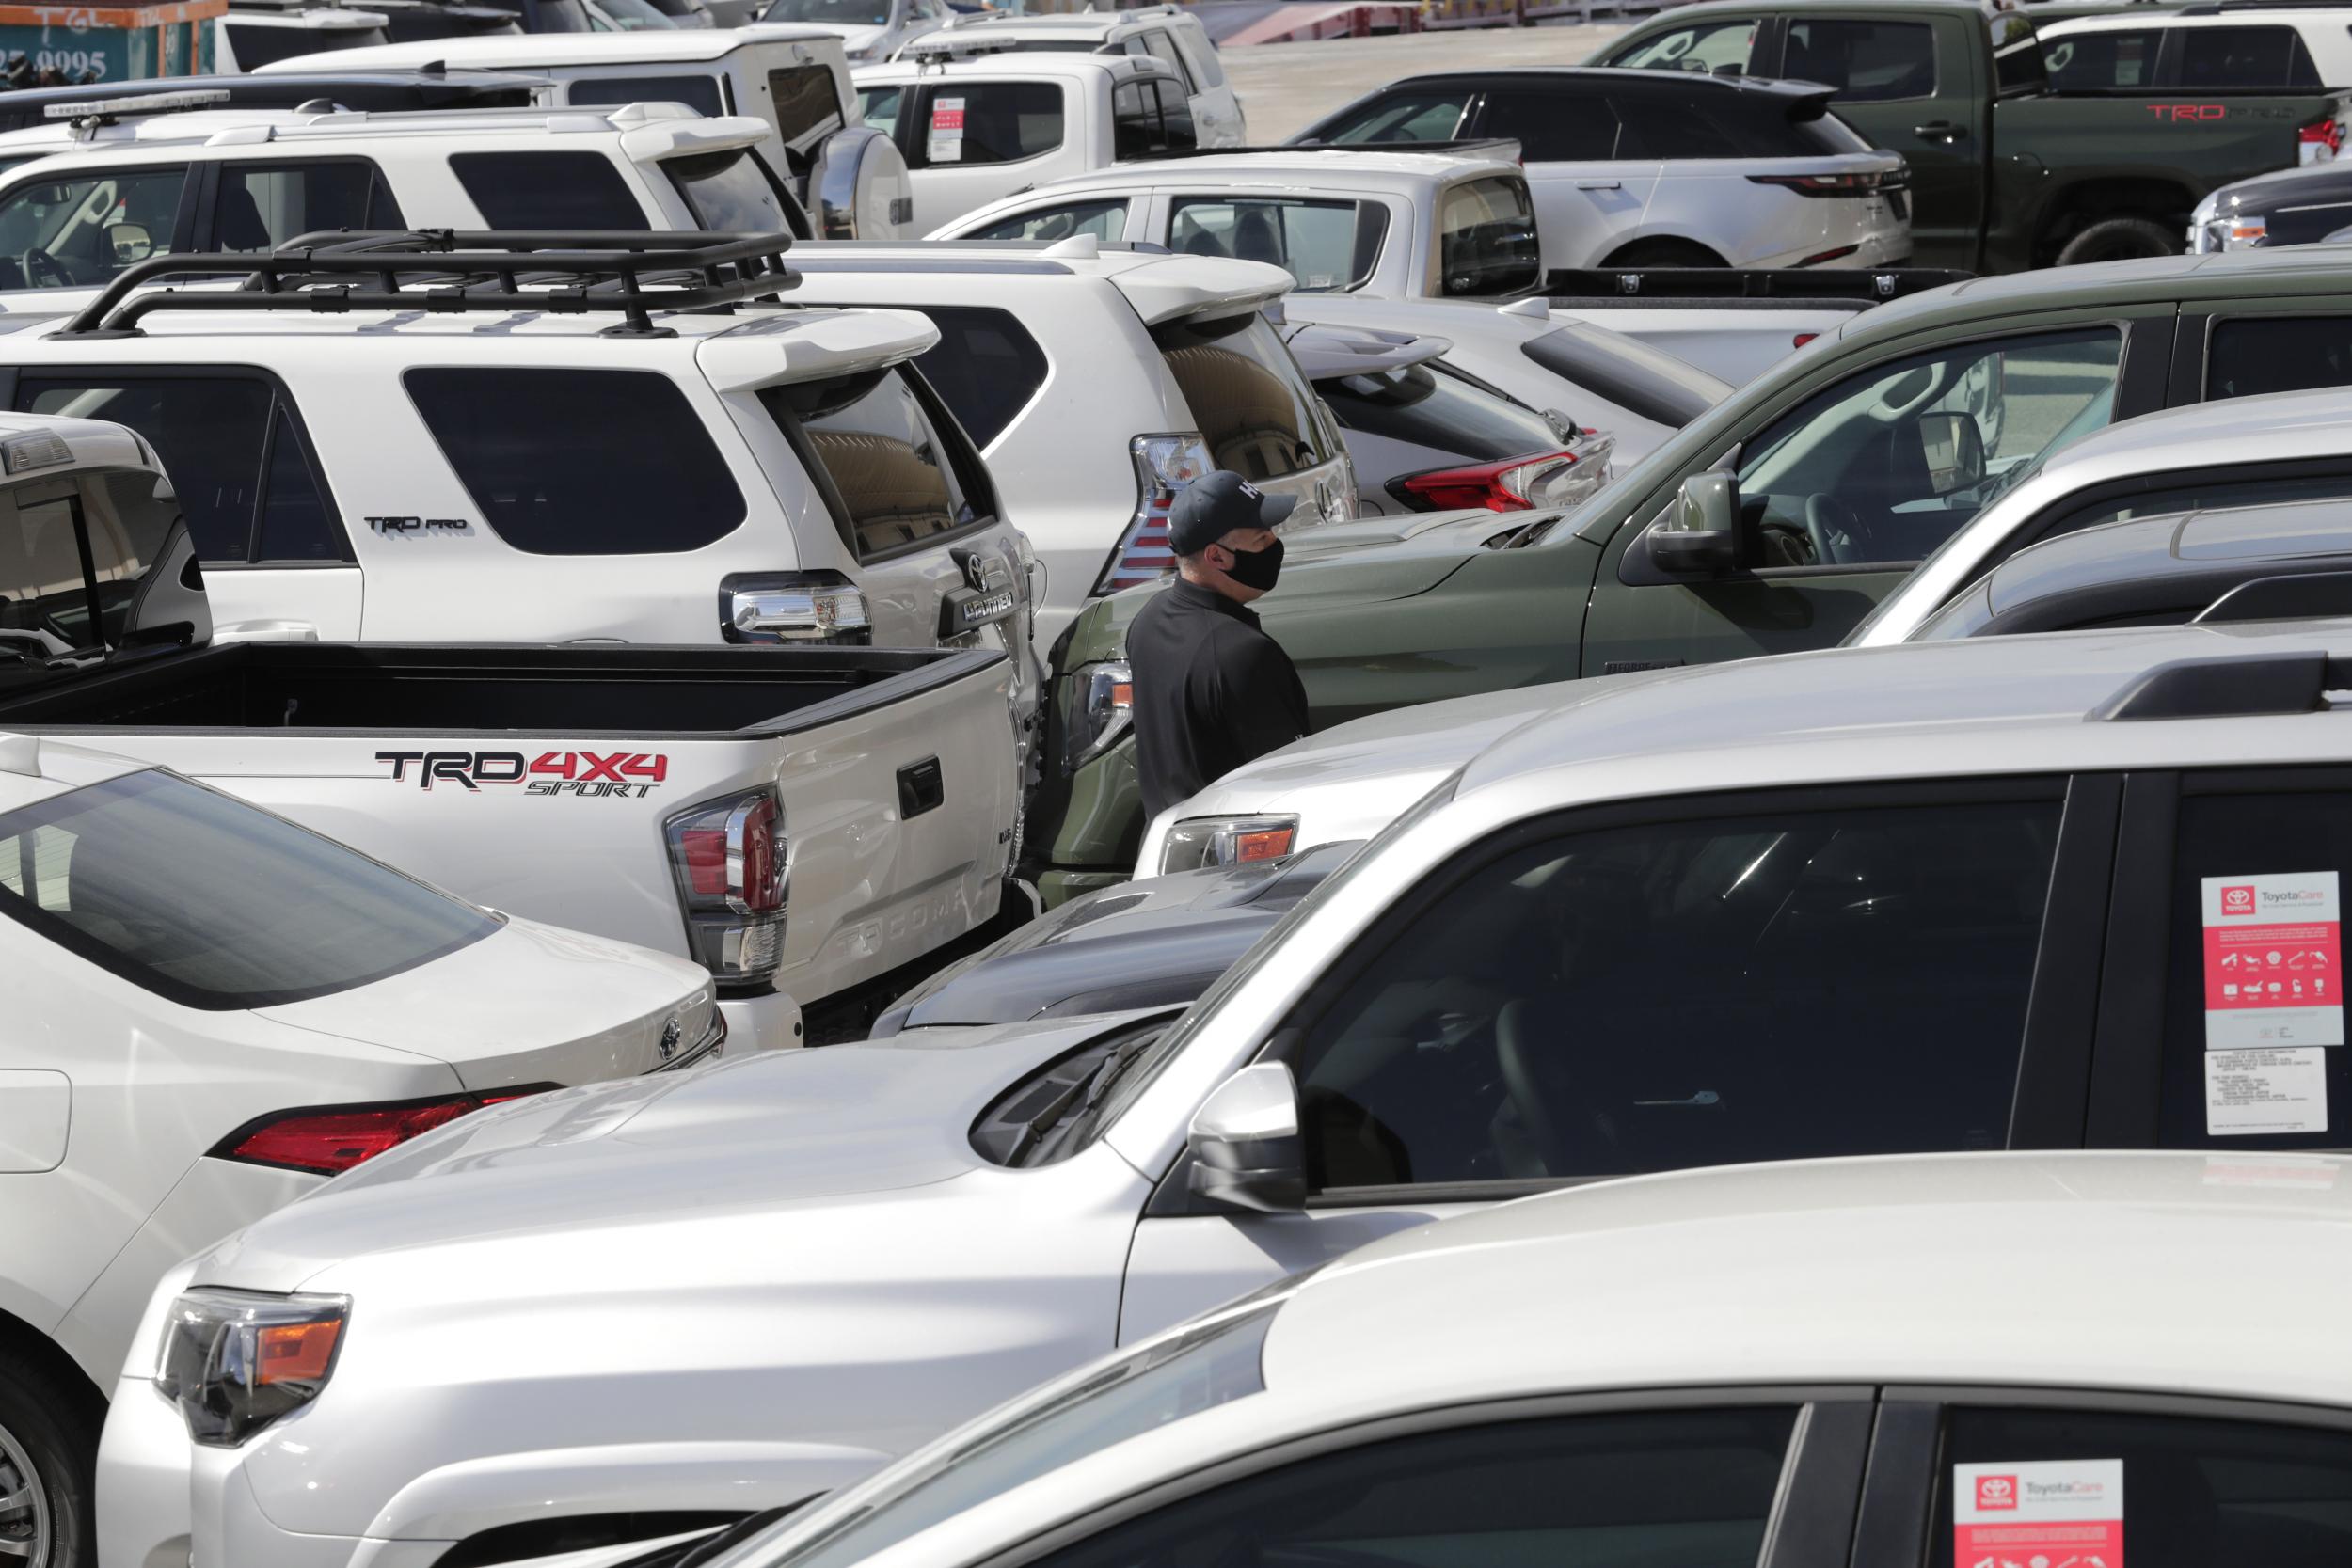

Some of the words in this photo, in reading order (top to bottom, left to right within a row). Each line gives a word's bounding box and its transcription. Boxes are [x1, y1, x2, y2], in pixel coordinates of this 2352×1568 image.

[2146, 105, 2225, 122] TRD
[363, 516, 421, 533] TRD
[425, 519, 467, 529] PRO
[524, 781, 661, 798] SPORT
[2262, 889, 2324, 903] ToyotaCare
[2026, 1481, 2104, 1495] ToyotaCare
